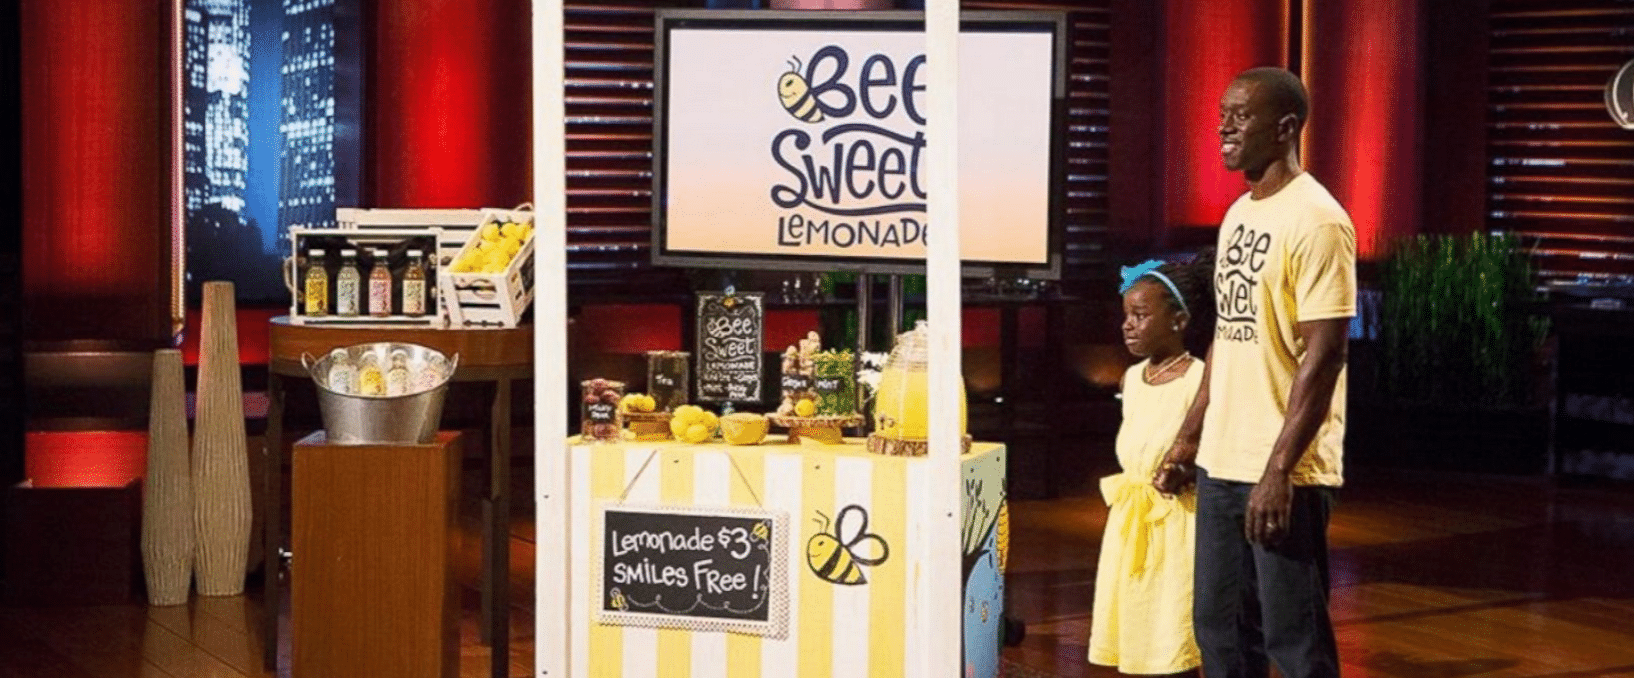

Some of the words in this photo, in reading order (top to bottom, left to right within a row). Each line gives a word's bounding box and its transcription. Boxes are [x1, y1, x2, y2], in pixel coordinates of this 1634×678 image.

[804, 45, 926, 125] Bee
[704, 337, 756, 361] Sweet
[612, 527, 714, 557] Lemonade
[717, 526, 751, 559] $3
